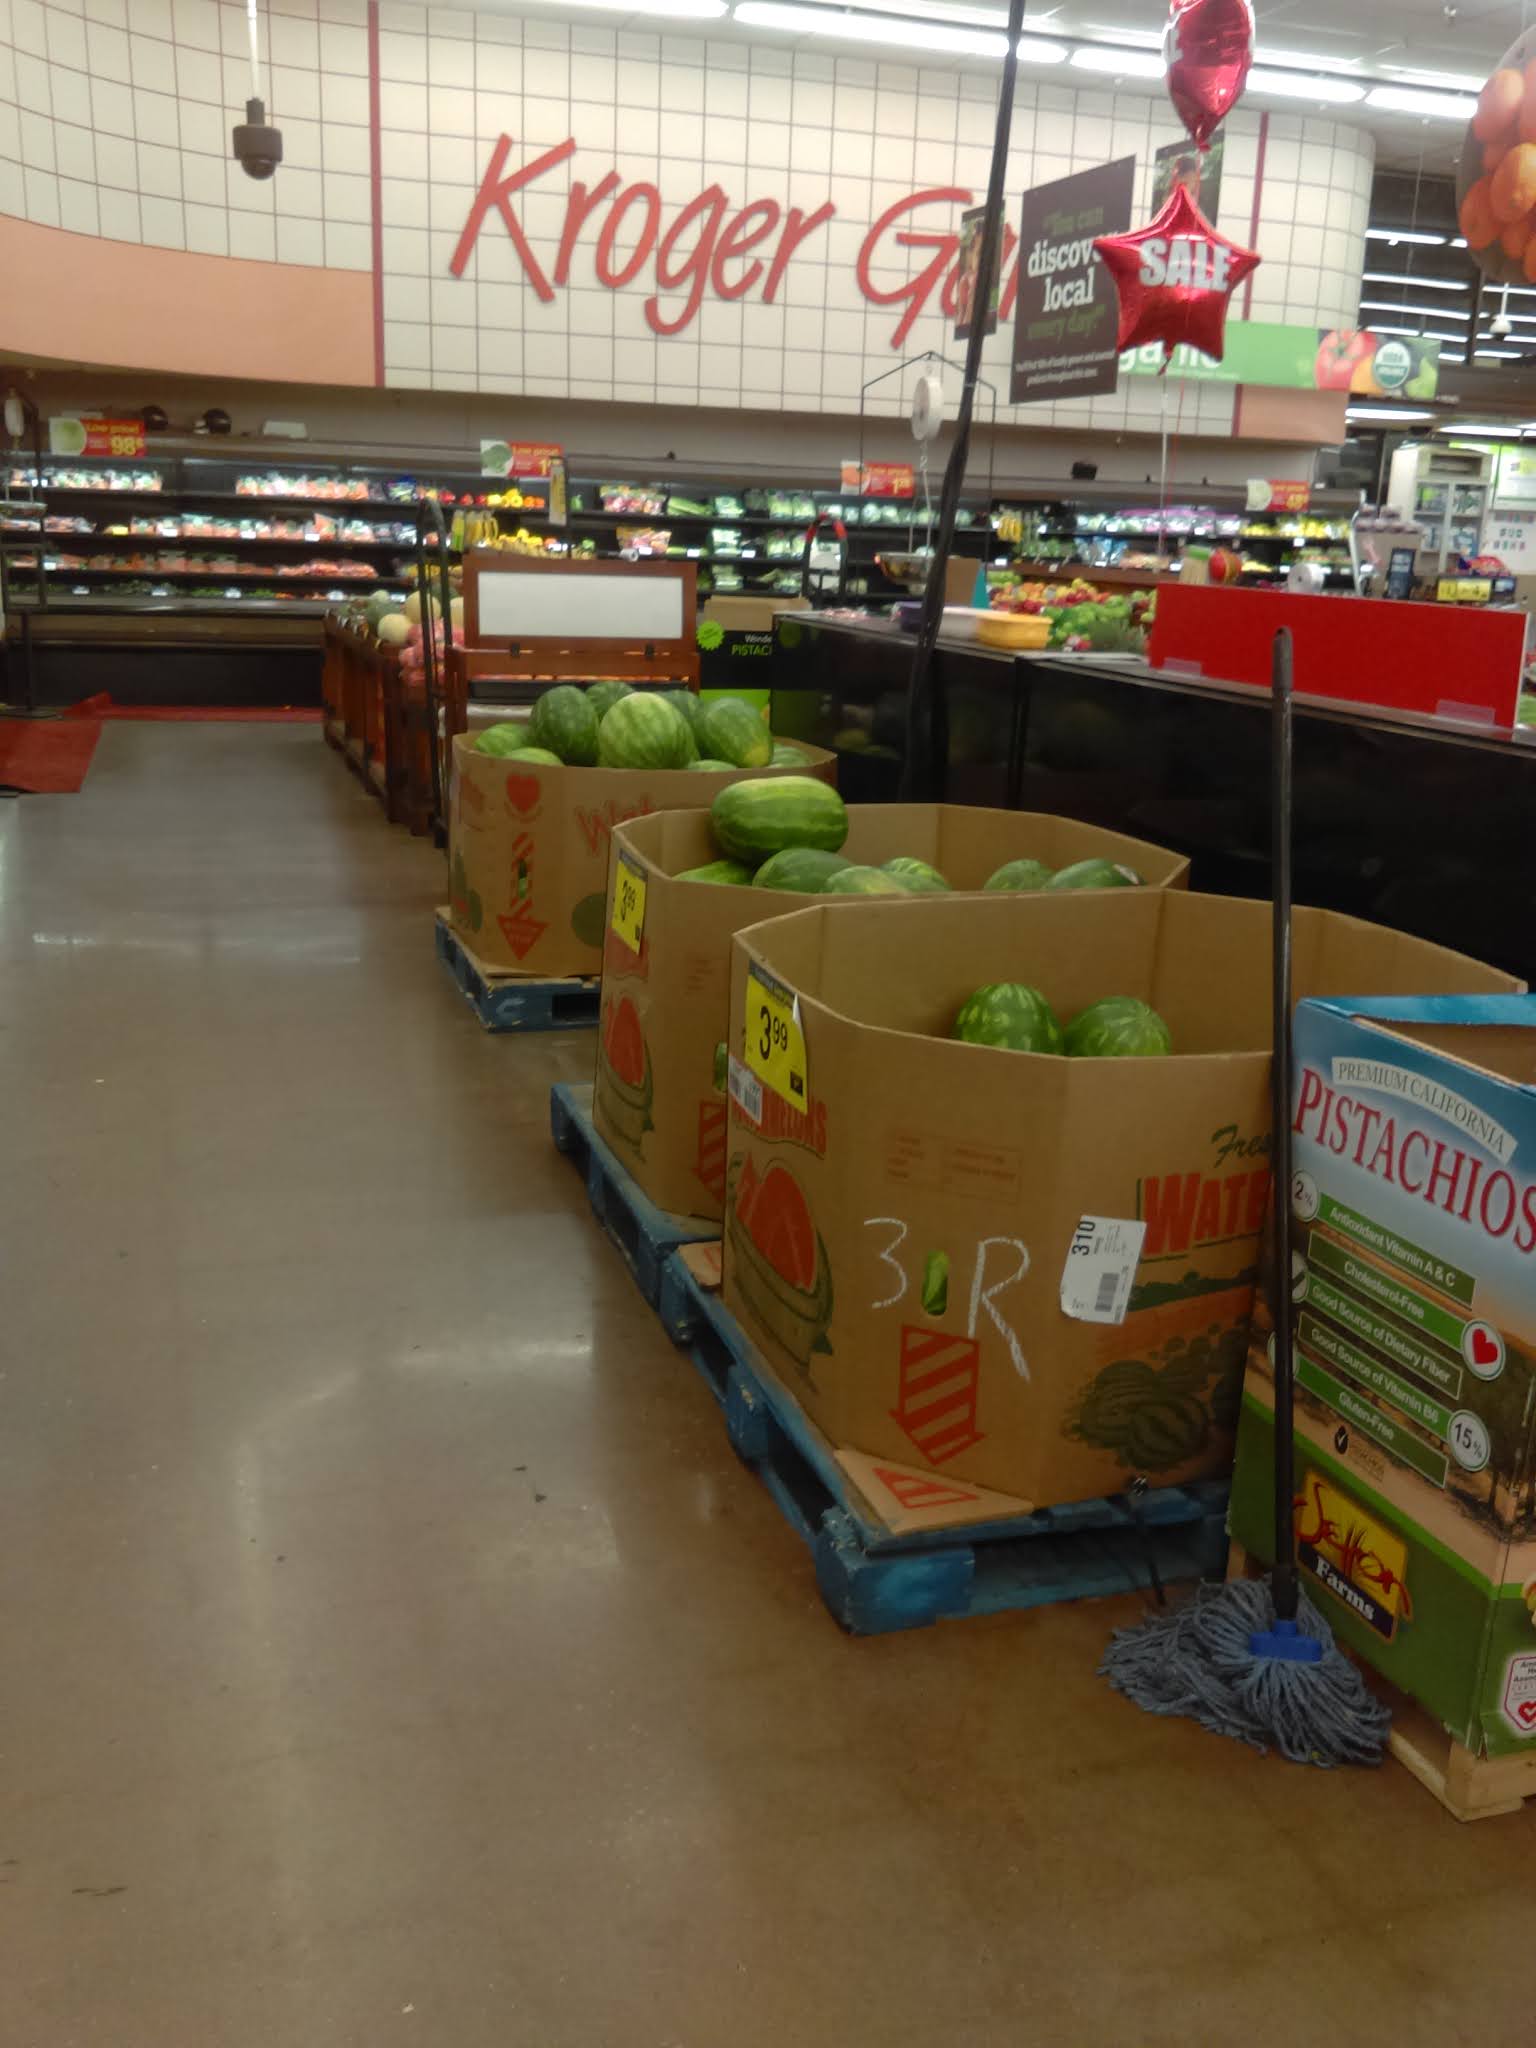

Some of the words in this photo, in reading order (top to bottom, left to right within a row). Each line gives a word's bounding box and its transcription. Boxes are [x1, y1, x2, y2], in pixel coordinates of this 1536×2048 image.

[449, 133, 836, 336] Kroger
[1027, 237, 1104, 278] discov
[1139, 236, 1232, 292] SALE
[1042, 266, 1097, 313] local
[1338, 1062, 1409, 1094] PREMIUM
[1409, 1078, 1505, 1154] CALIFORNIA
[1292, 1067, 1536, 1253] PISTACHIOS
[863, 1216, 908, 1310] 3
[1072, 1221, 1096, 1256] 310
[1330, 1207, 1385, 1248] Antioxidant
[1385, 1237, 1424, 1270] Vitamin
[1424, 1261, 1434, 1276] A
[1434, 1267, 1444, 1281] &
[1445, 1273, 1457, 1288] C
[967, 1236, 1031, 1383] R
[1312, 1285, 1338, 1310] Good
[1338, 1300, 1373, 1335] Source
[1373, 1327, 1385, 1341] of
[1385, 1332, 1421, 1367] Dietary
[1422, 1353, 1451, 1384] Fiber
[1311, 1327, 1337, 1353] Good
[1337, 1343, 1371, 1378] Source
[1372, 1371, 1385, 1386] of
[1384, 1376, 1422, 1413] Vitamin
[1315, 1554, 1376, 1621] Farms
